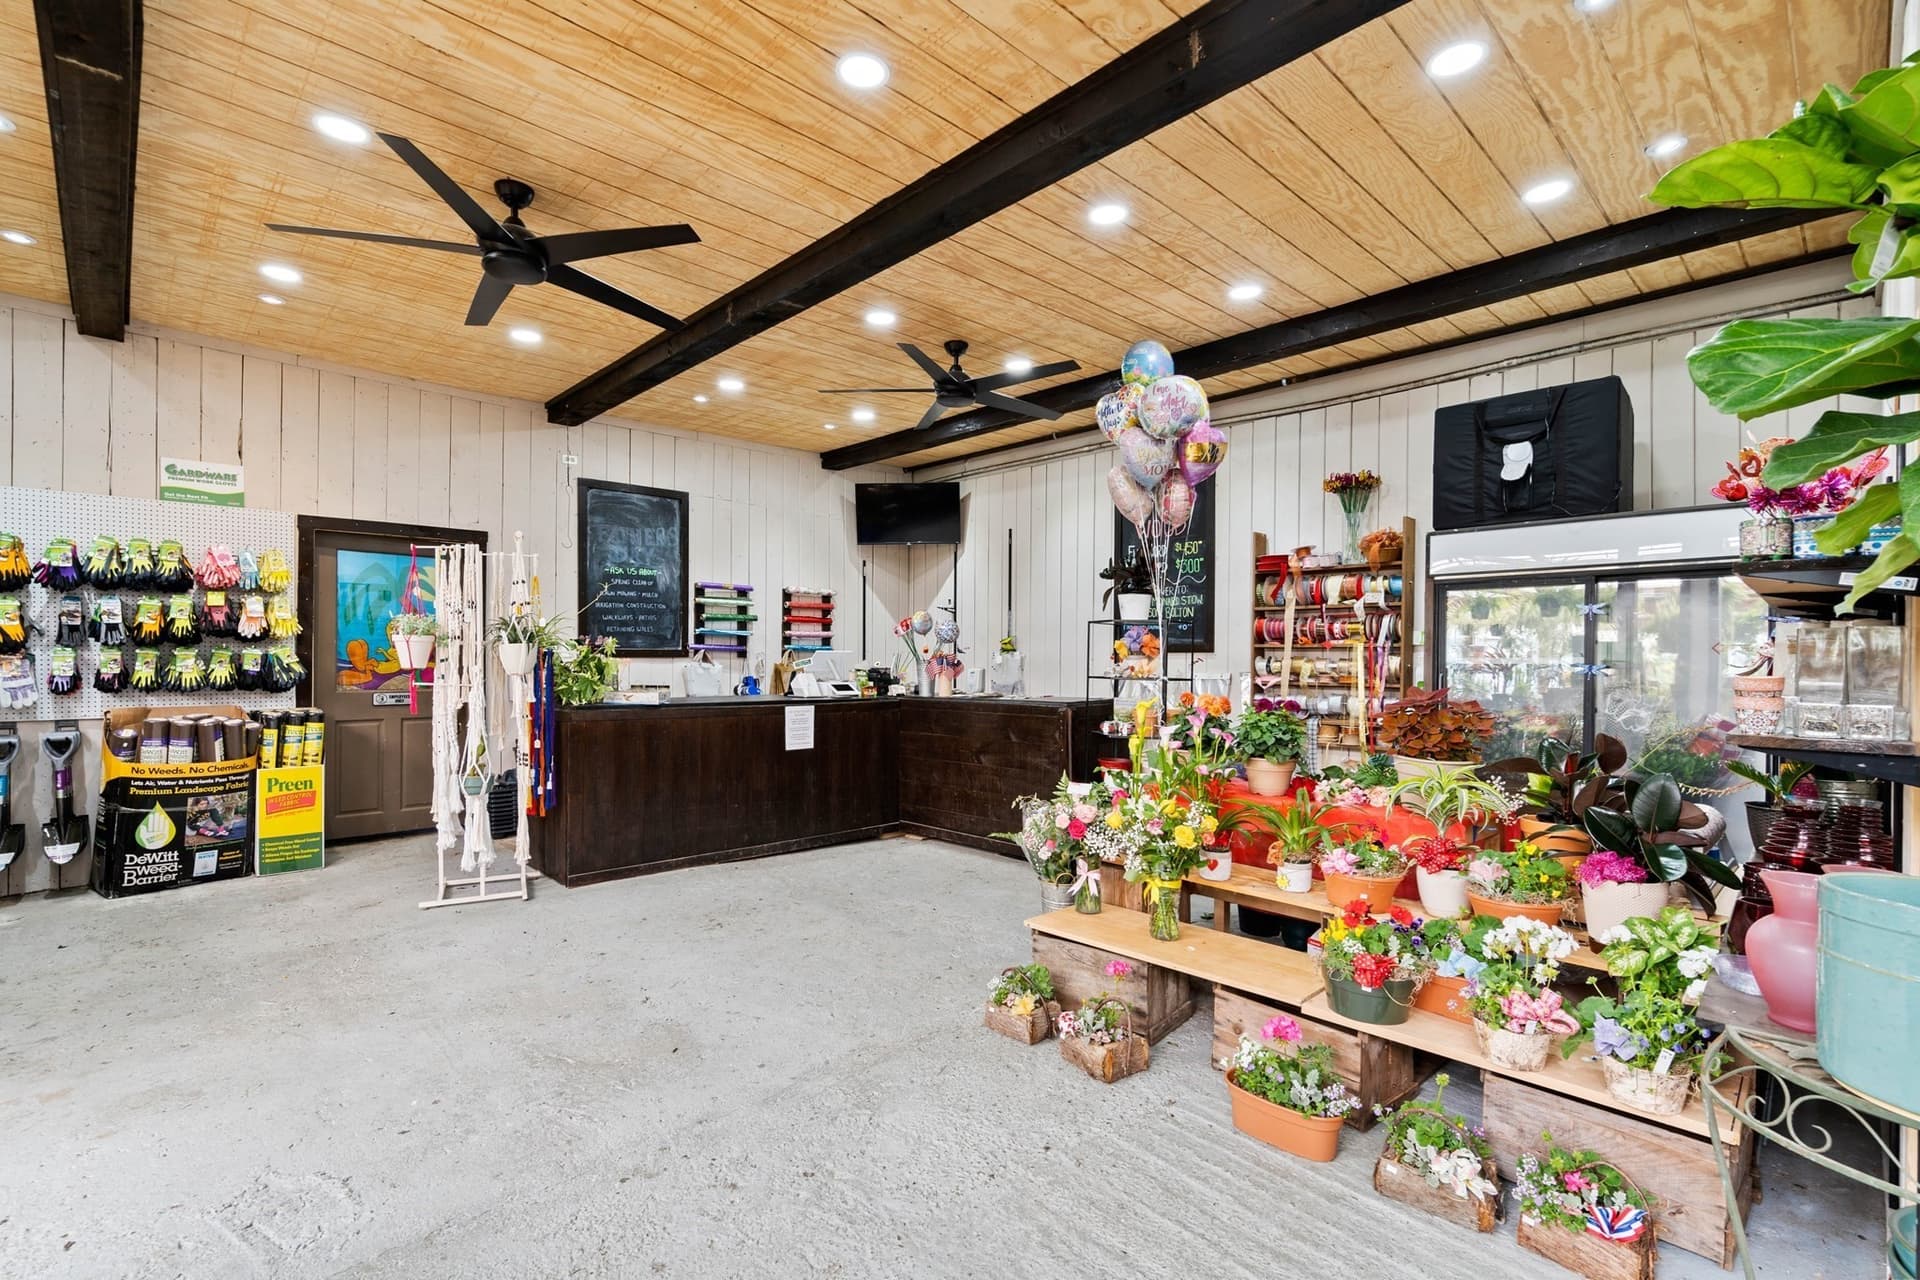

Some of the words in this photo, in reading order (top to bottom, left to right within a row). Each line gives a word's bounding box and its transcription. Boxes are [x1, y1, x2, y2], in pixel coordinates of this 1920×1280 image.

[627, 567, 638, 575] US
[131, 766, 146, 775] No
[148, 766, 186, 775] Weeds.
[189, 766, 205, 774] No
[129, 786, 173, 795] Premium
[174, 785, 224, 795] Landscape
[267, 777, 313, 793] Preen
[124, 850, 180, 865] DeWitt
[122, 870, 178, 887] Barrier
